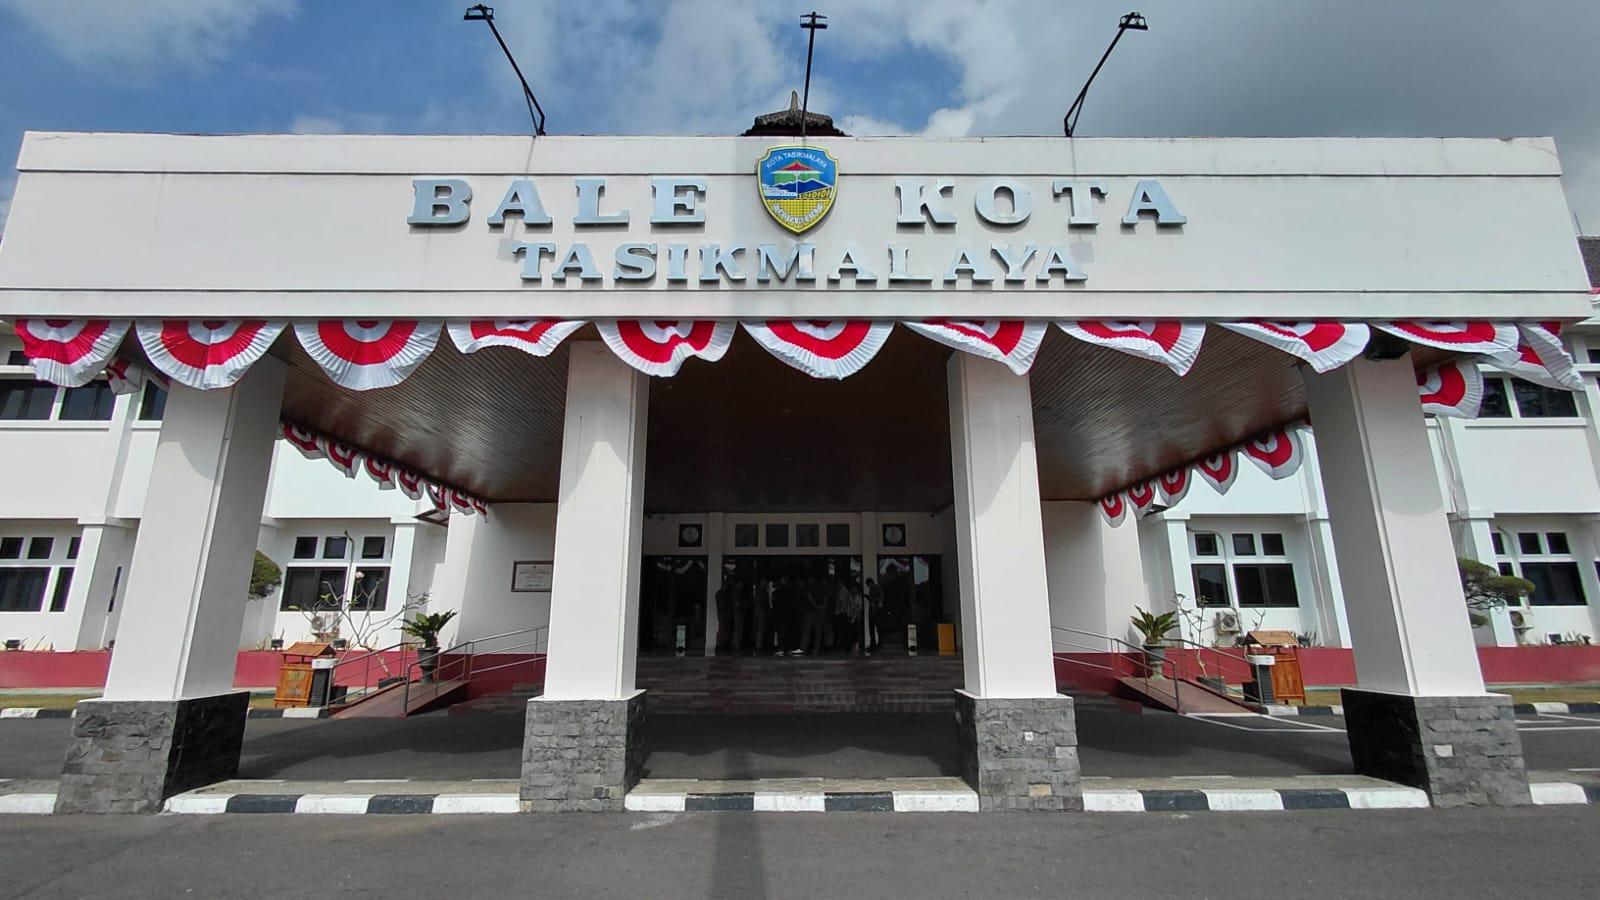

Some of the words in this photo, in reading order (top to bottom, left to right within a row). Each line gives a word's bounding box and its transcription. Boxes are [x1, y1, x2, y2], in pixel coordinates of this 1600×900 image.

[766, 155, 784, 169] KOTA
[783, 151, 828, 169] TASIKMALAYA
[406, 178, 708, 226] BALE
[894, 179, 1188, 226] KOTA
[511, 242, 1089, 283] TASIKMALAYA
